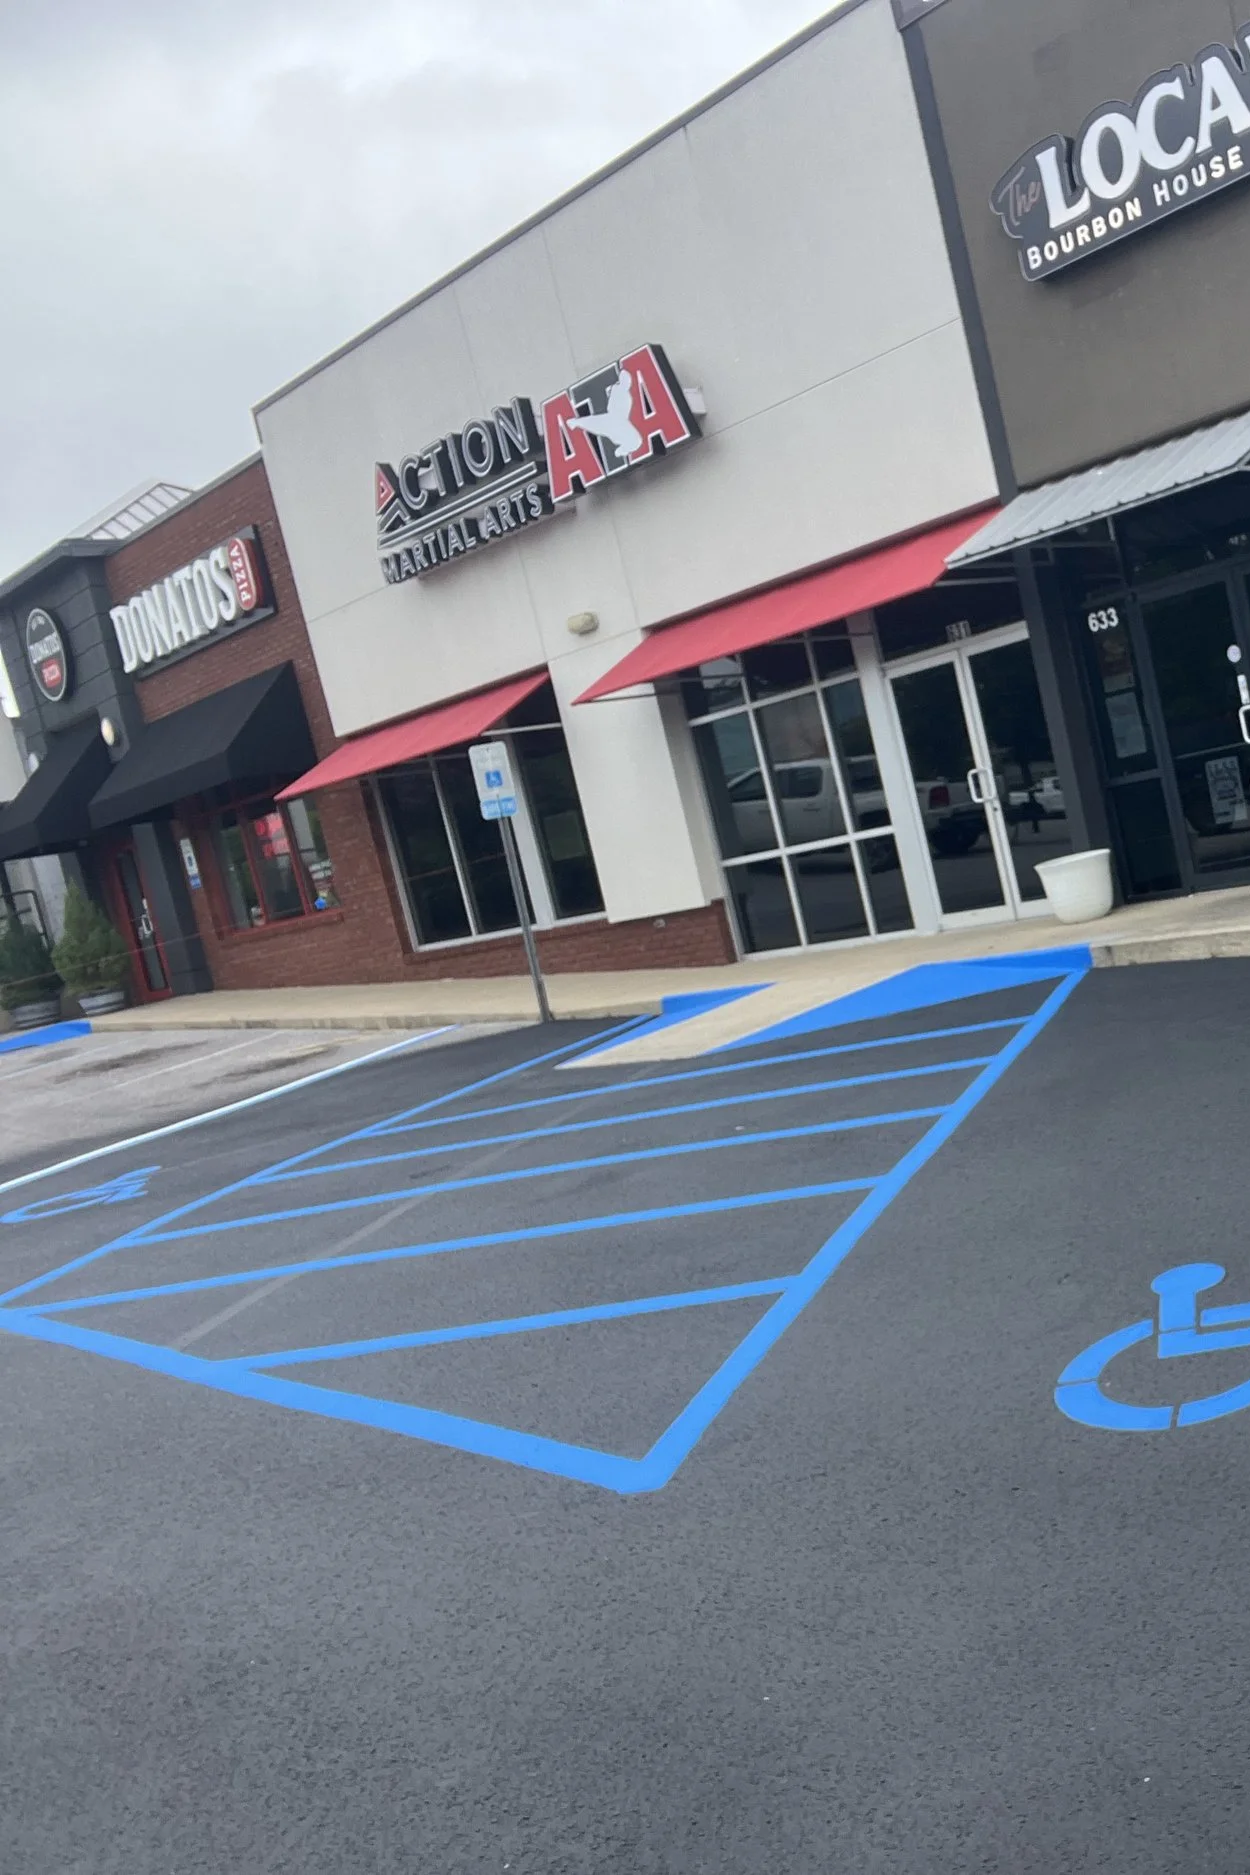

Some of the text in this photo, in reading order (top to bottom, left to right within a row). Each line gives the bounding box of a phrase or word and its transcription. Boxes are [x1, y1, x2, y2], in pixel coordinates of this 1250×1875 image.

[998, 166, 1042, 226] The
[1026, 197, 1142, 270] BOURBON
[1153, 145, 1244, 206] HOUSE
[375, 396, 534, 533] ACTION
[541, 343, 693, 503] ATA
[230, 543, 252, 602] PIZZA
[380, 482, 544, 585] MARTIAL ARTS
[109, 546, 238, 674] DONATOS
[1088, 607, 1119, 632] 633
